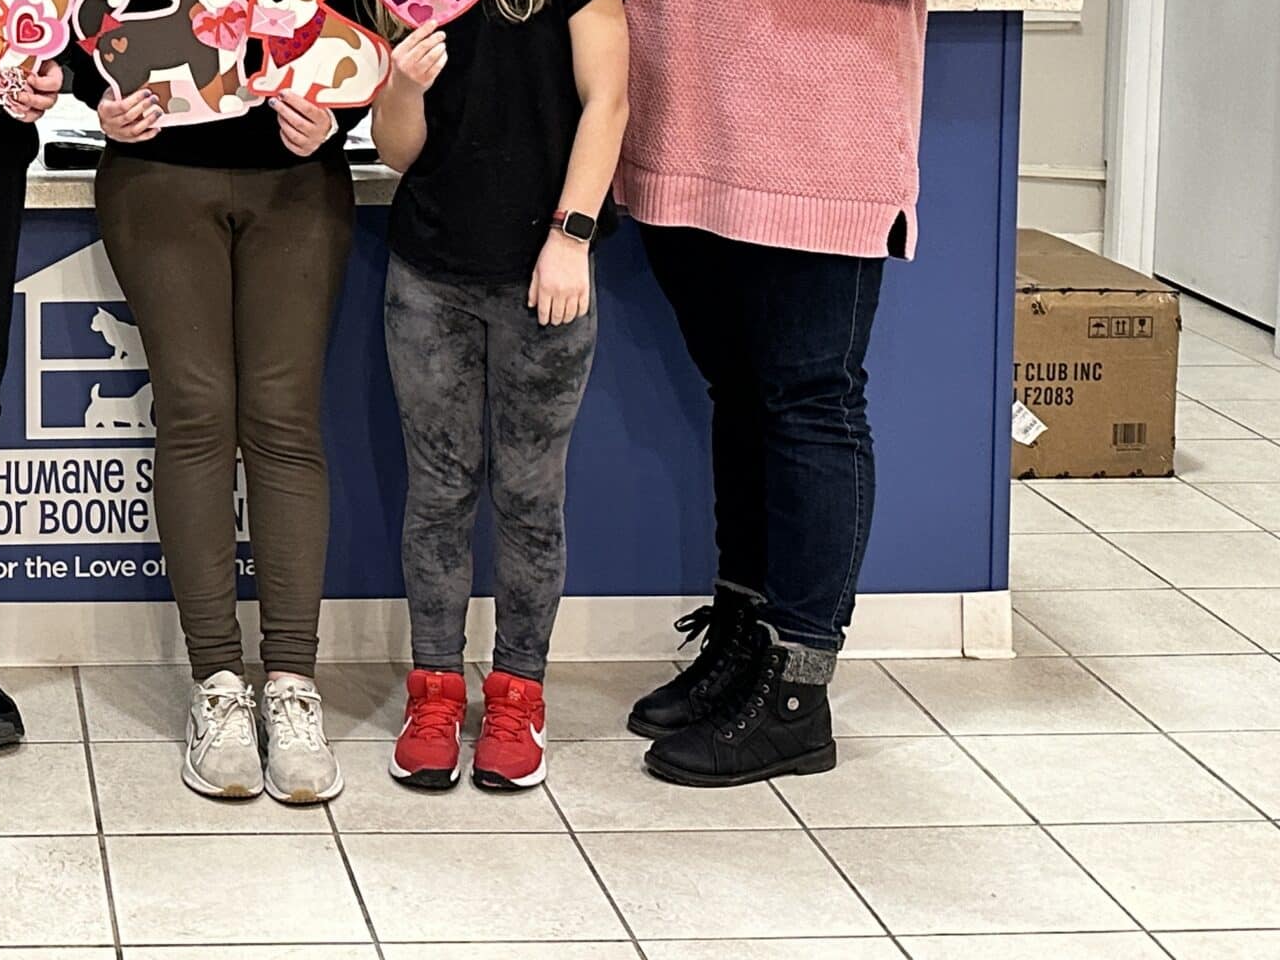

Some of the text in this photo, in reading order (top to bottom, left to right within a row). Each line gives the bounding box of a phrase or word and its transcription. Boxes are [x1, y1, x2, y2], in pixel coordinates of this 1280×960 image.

[1025, 362, 1069, 382] CLUB
[1073, 362, 1103, 381] INC
[24, 555, 68, 579] the
[74, 555, 137, 578] Love
